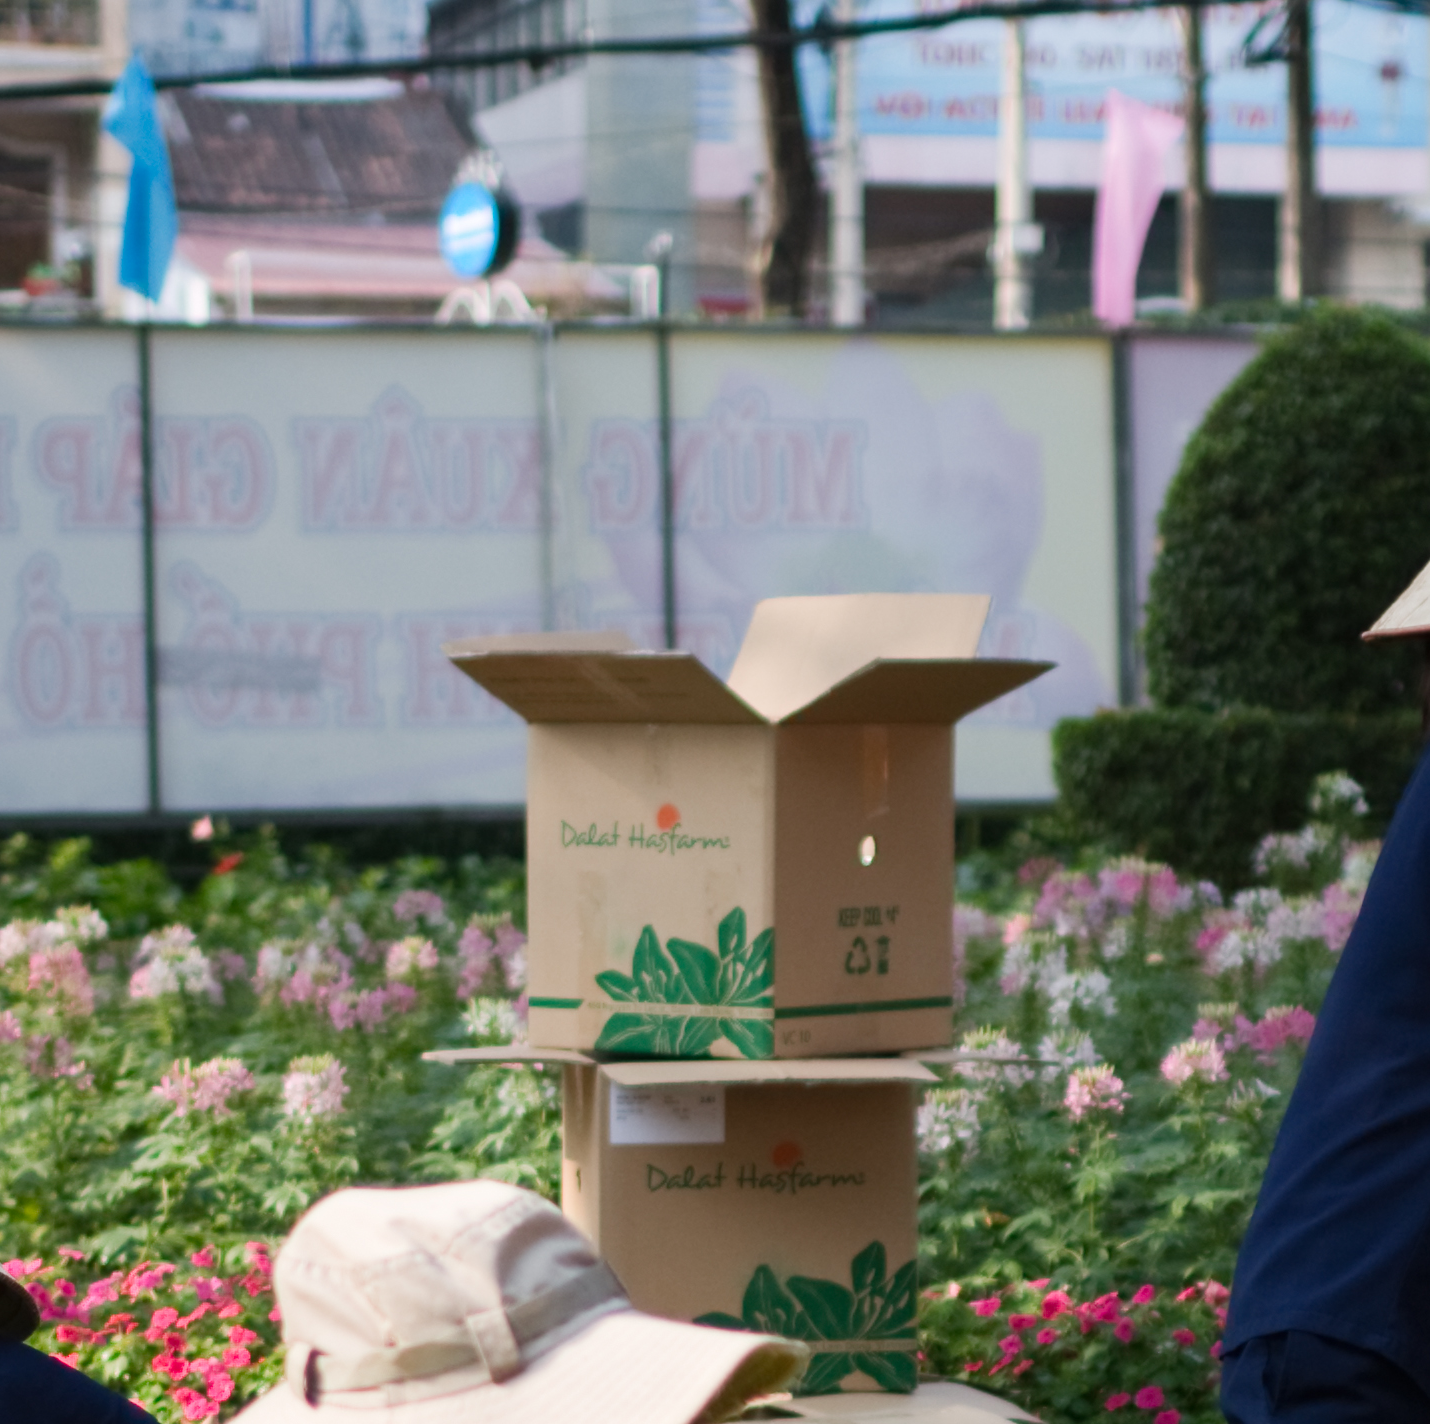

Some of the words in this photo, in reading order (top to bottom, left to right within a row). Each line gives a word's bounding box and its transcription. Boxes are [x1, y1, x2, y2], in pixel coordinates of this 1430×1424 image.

[560, 819, 621, 850] Dalat
[628, 822, 727, 856] Hasfarm
[646, 1162, 727, 1193] Dalat
[737, 1162, 863, 1196] Hasfarm
